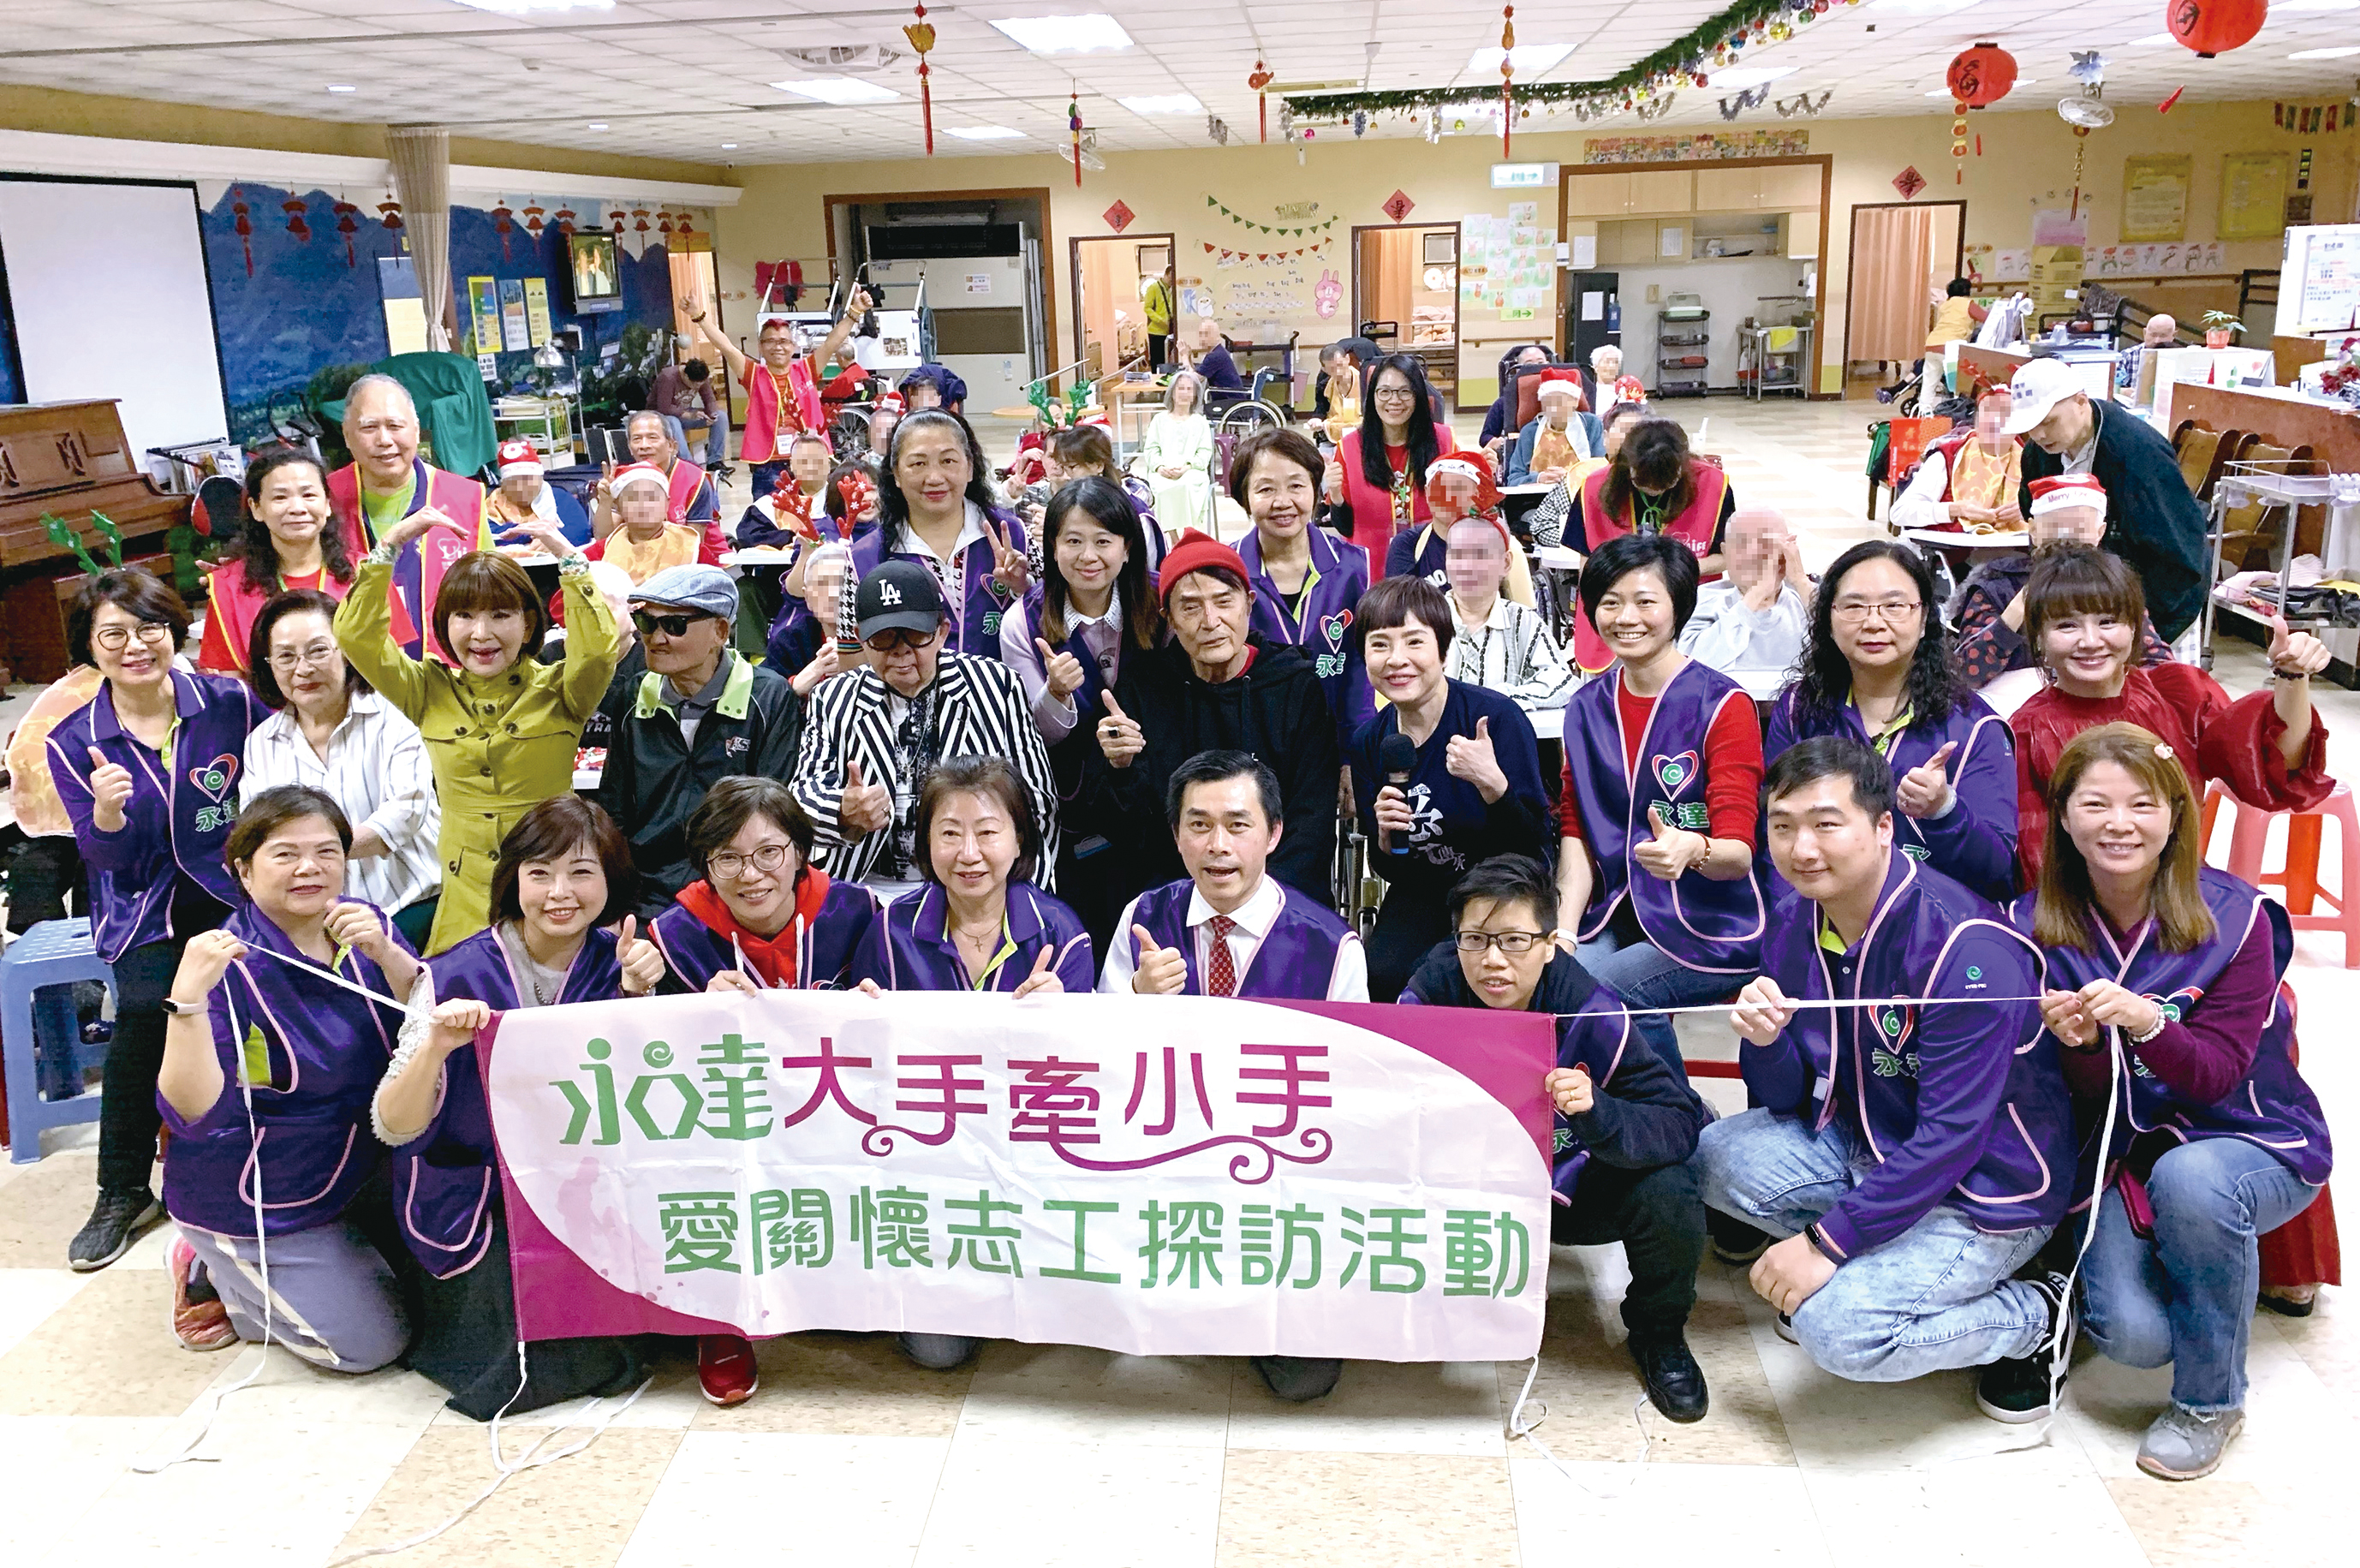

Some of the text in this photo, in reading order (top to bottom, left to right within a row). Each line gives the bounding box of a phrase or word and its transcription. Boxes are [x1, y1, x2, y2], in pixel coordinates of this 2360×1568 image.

[878, 579, 903, 606] LA
[1648, 799, 1710, 829] 永達
[657, 1185, 1531, 1300] 愛關懷志工探訪活動
